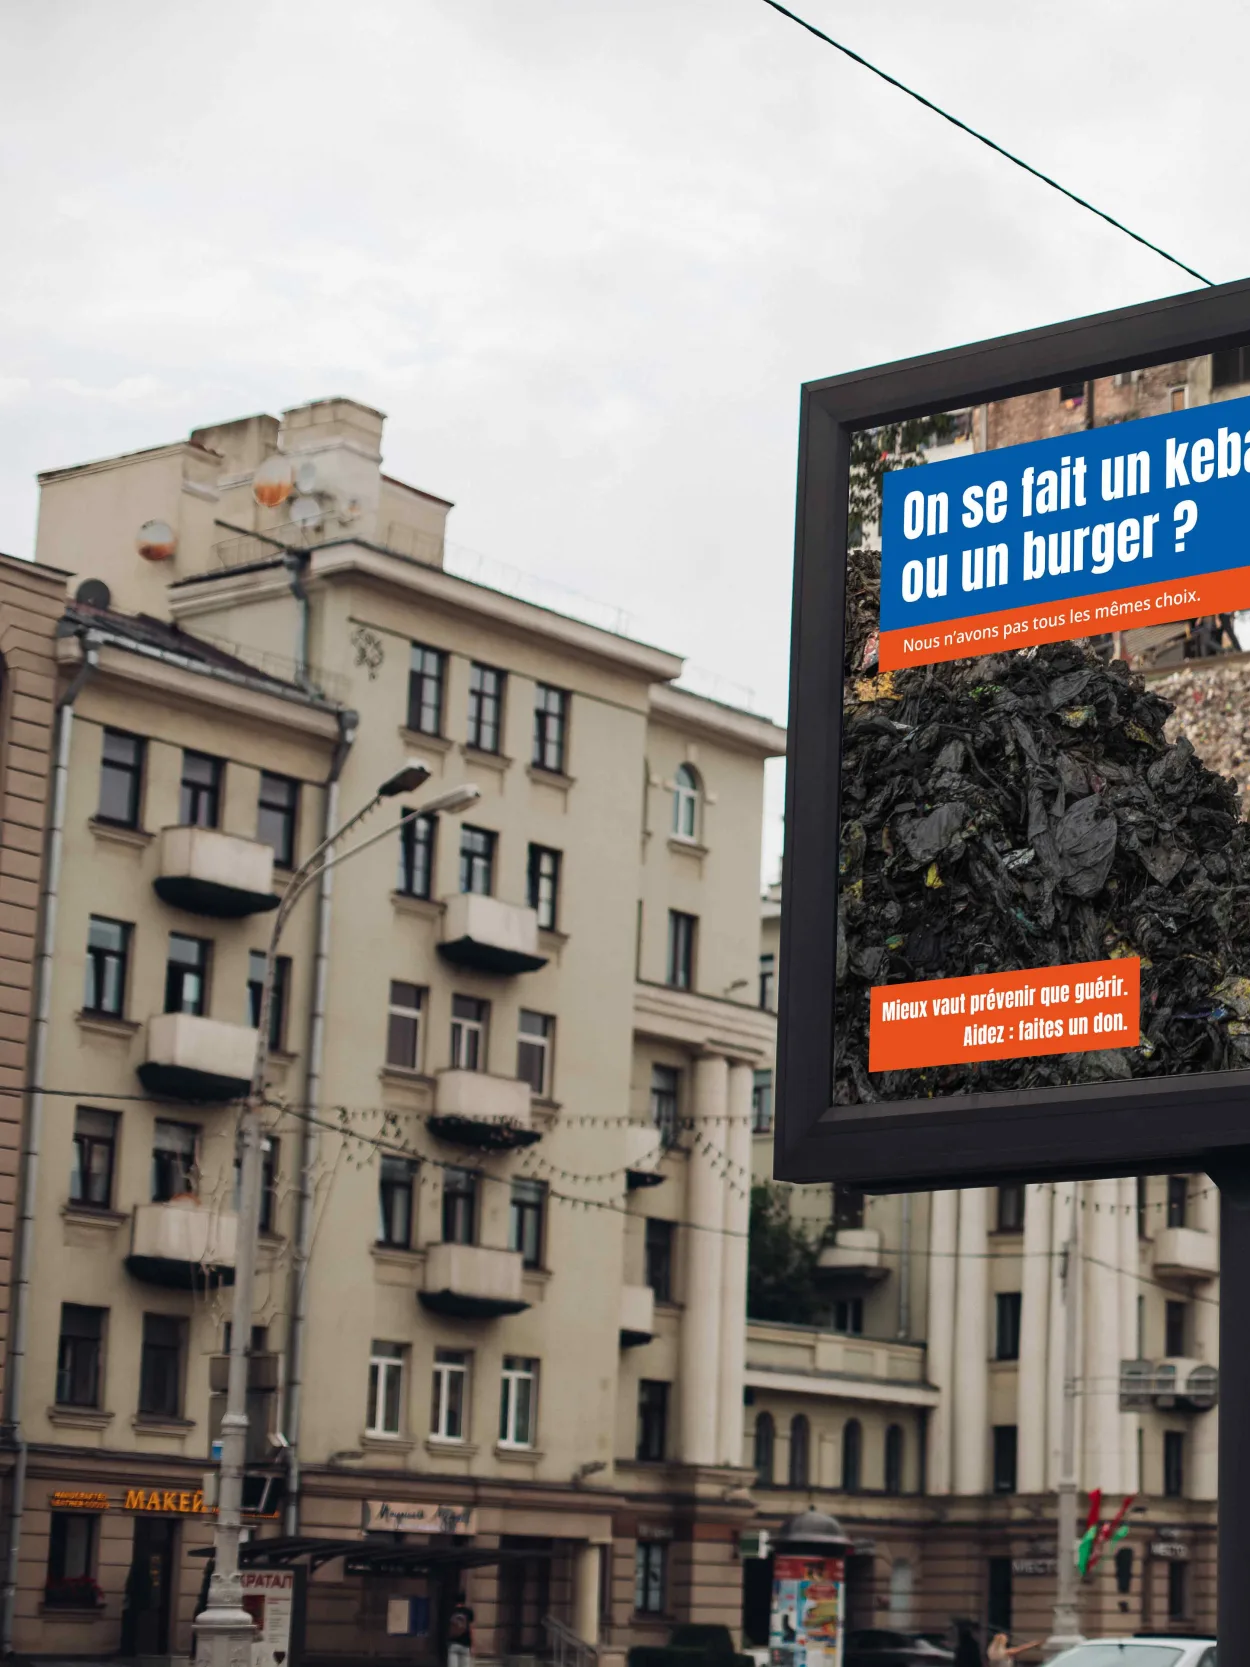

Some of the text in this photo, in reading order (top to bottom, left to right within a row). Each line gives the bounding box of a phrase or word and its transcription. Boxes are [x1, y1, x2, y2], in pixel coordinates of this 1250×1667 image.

[903, 491, 949, 540] On
[962, 481, 1008, 529] se
[1022, 455, 1087, 517] fait
[1101, 451, 1150, 502] un
[902, 499, 1198, 603] ou un burger ?
[903, 589, 1201, 653] Nous n’avons pas tous les mêmes choix.
[882, 975, 1128, 1022] Mieux vaut prévenir que guérir.
[963, 1012, 1128, 1046] Aidez : faites un don.
